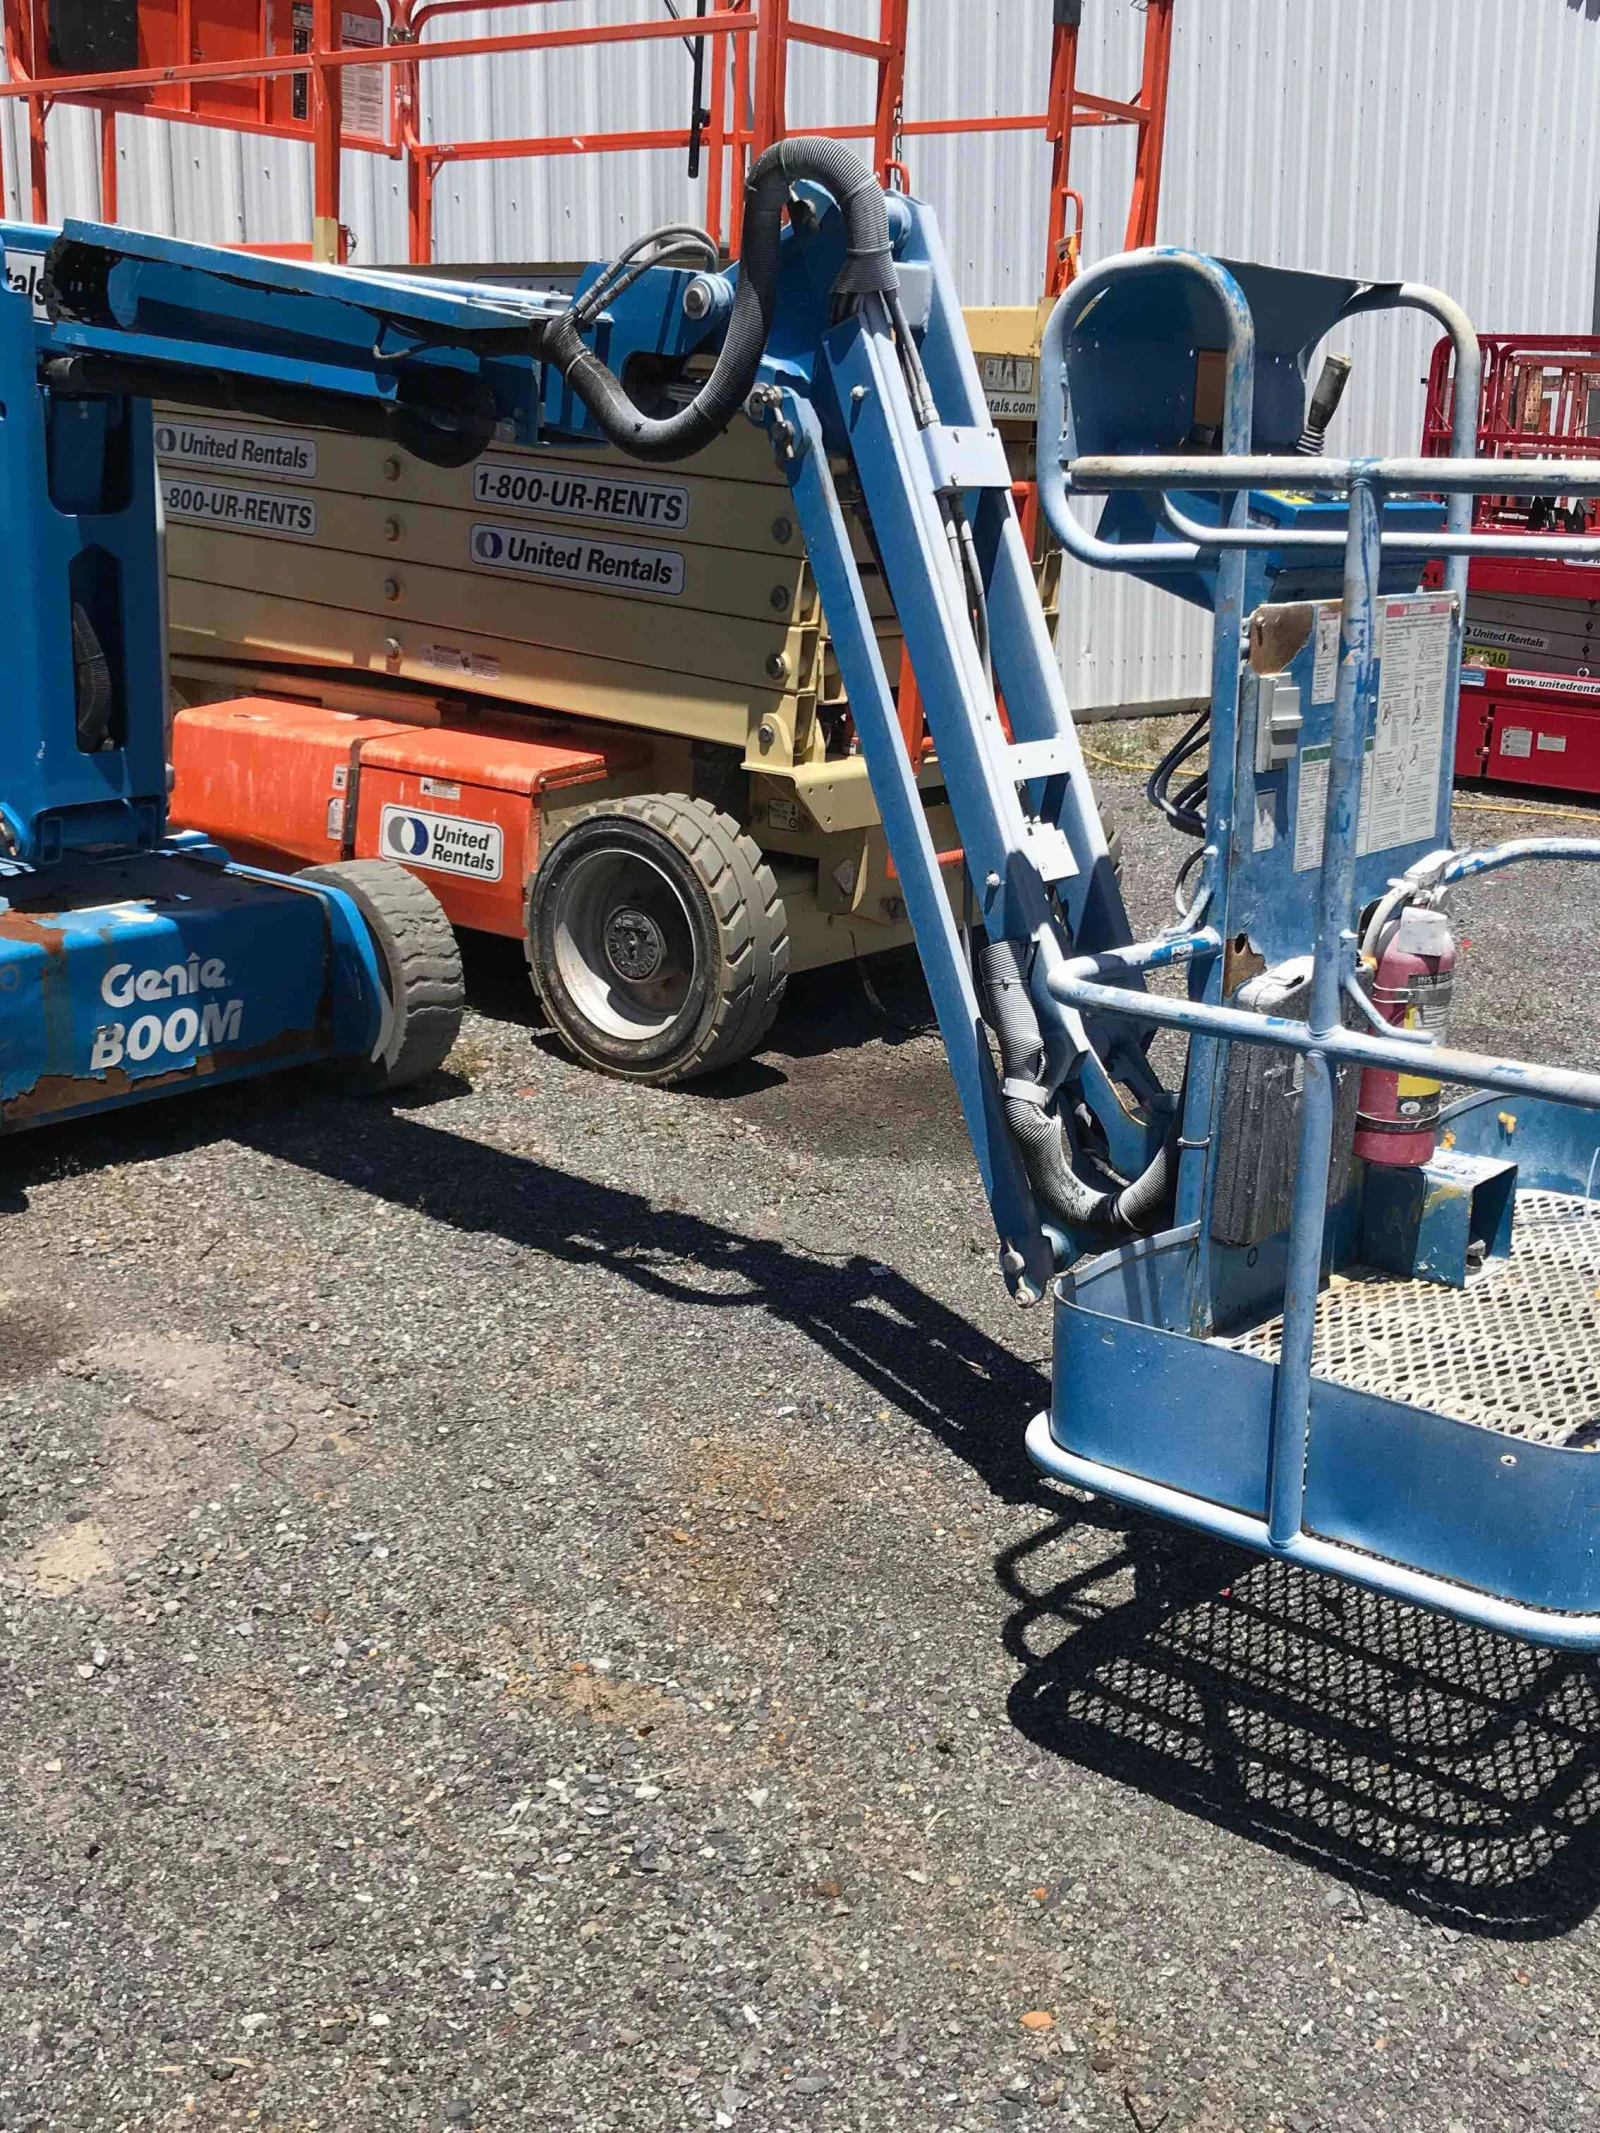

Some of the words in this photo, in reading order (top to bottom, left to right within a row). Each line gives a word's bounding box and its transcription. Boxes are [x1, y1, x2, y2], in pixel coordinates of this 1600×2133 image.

[181, 431, 239, 460] United
[241, 439, 309, 469] Rentals
[479, 472, 683, 522] 1-800-UR-RENTS
[507, 536, 583, 571] United
[586, 548, 673, 585] Rentals
[1472, 627, 1507, 641] United
[1507, 633, 1545, 648] Rentals
[431, 843, 495, 872] Rentals
[433, 823, 490, 851] United
[101, 951, 226, 1008] Genie
[90, 999, 244, 1071] BOOM
